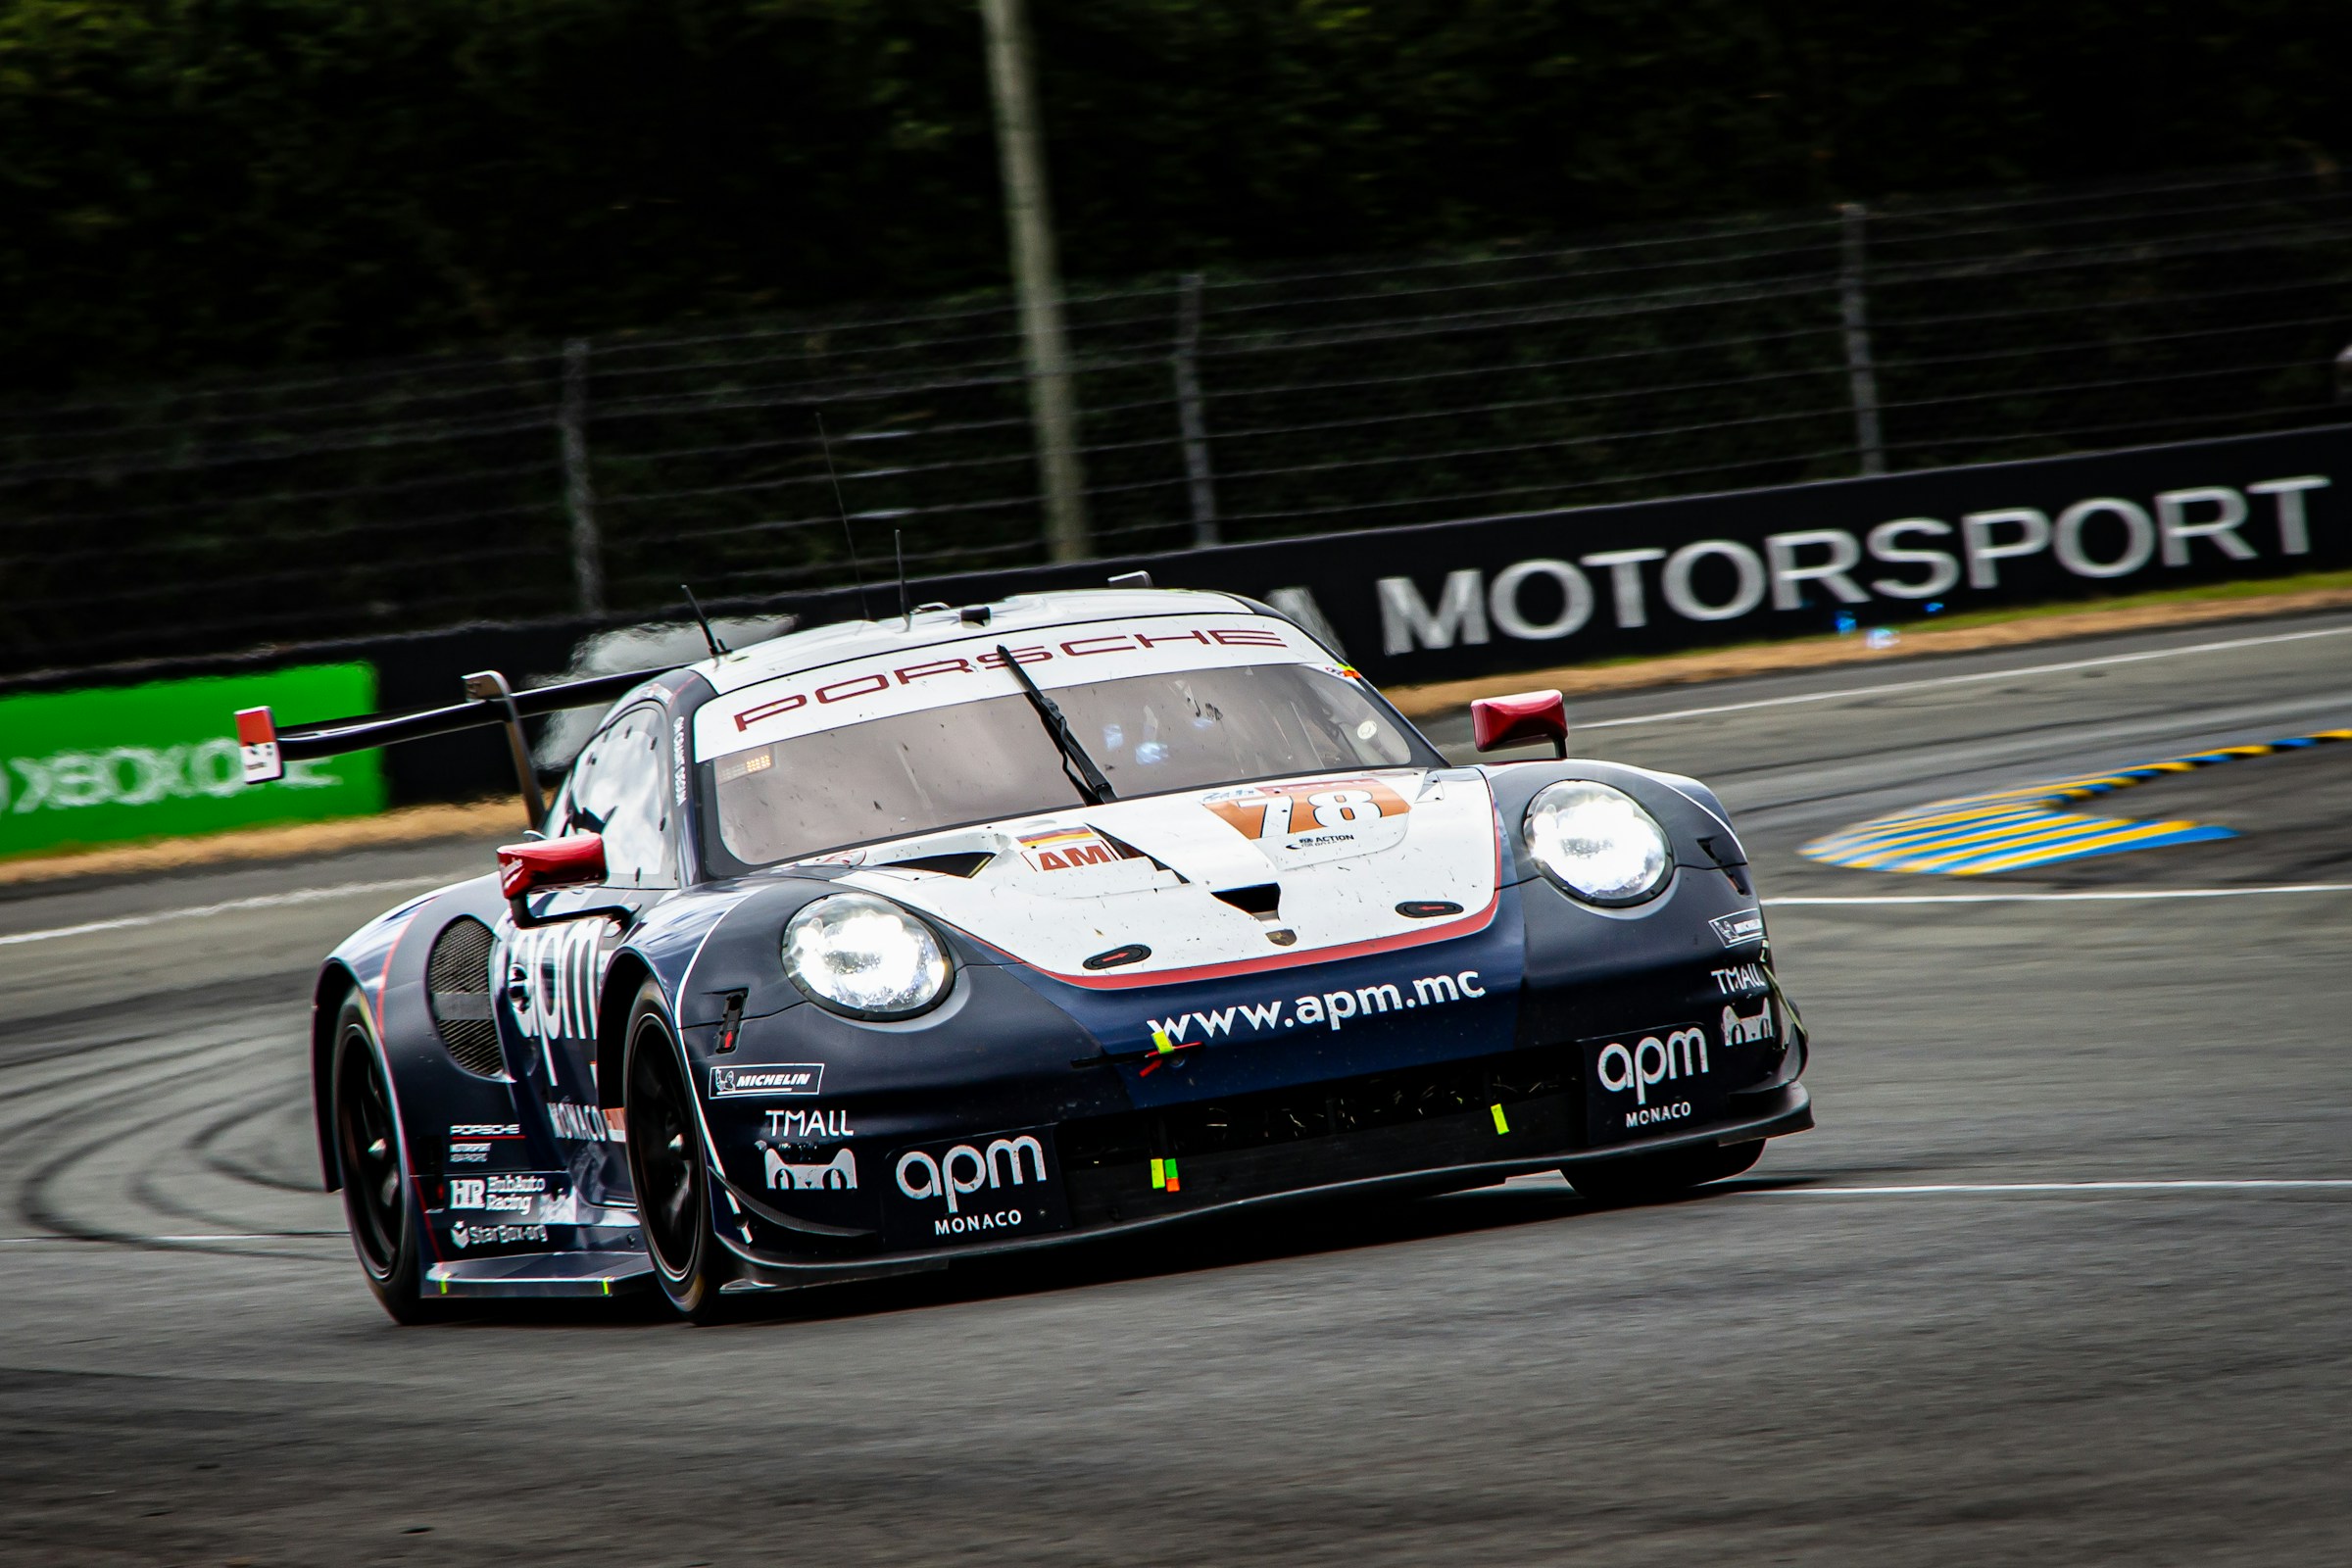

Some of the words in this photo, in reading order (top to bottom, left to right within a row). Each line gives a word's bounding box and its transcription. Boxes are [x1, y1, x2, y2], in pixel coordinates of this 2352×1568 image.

[1376, 474, 2330, 657] MOTORSPORT
[734, 629, 1288, 732] PORSCHE
[1237, 789, 1383, 839] 78
[1315, 834, 1355, 843] ACTION
[1039, 845, 1111, 871] AM
[1710, 962, 1766, 995] TMALL
[1147, 969, 1487, 1043] www.apm.mc
[736, 1072, 810, 1089] MICHELIN
[1596, 1026, 1709, 1105] apm
[450, 1123, 521, 1136] PORSCHE
[764, 1109, 855, 1138] TMALL
[1625, 1101, 1691, 1128] MONACO
[895, 1134, 1048, 1213] apm
[485, 1194, 534, 1216] Racing
[933, 1207, 1023, 1237] MONACO
